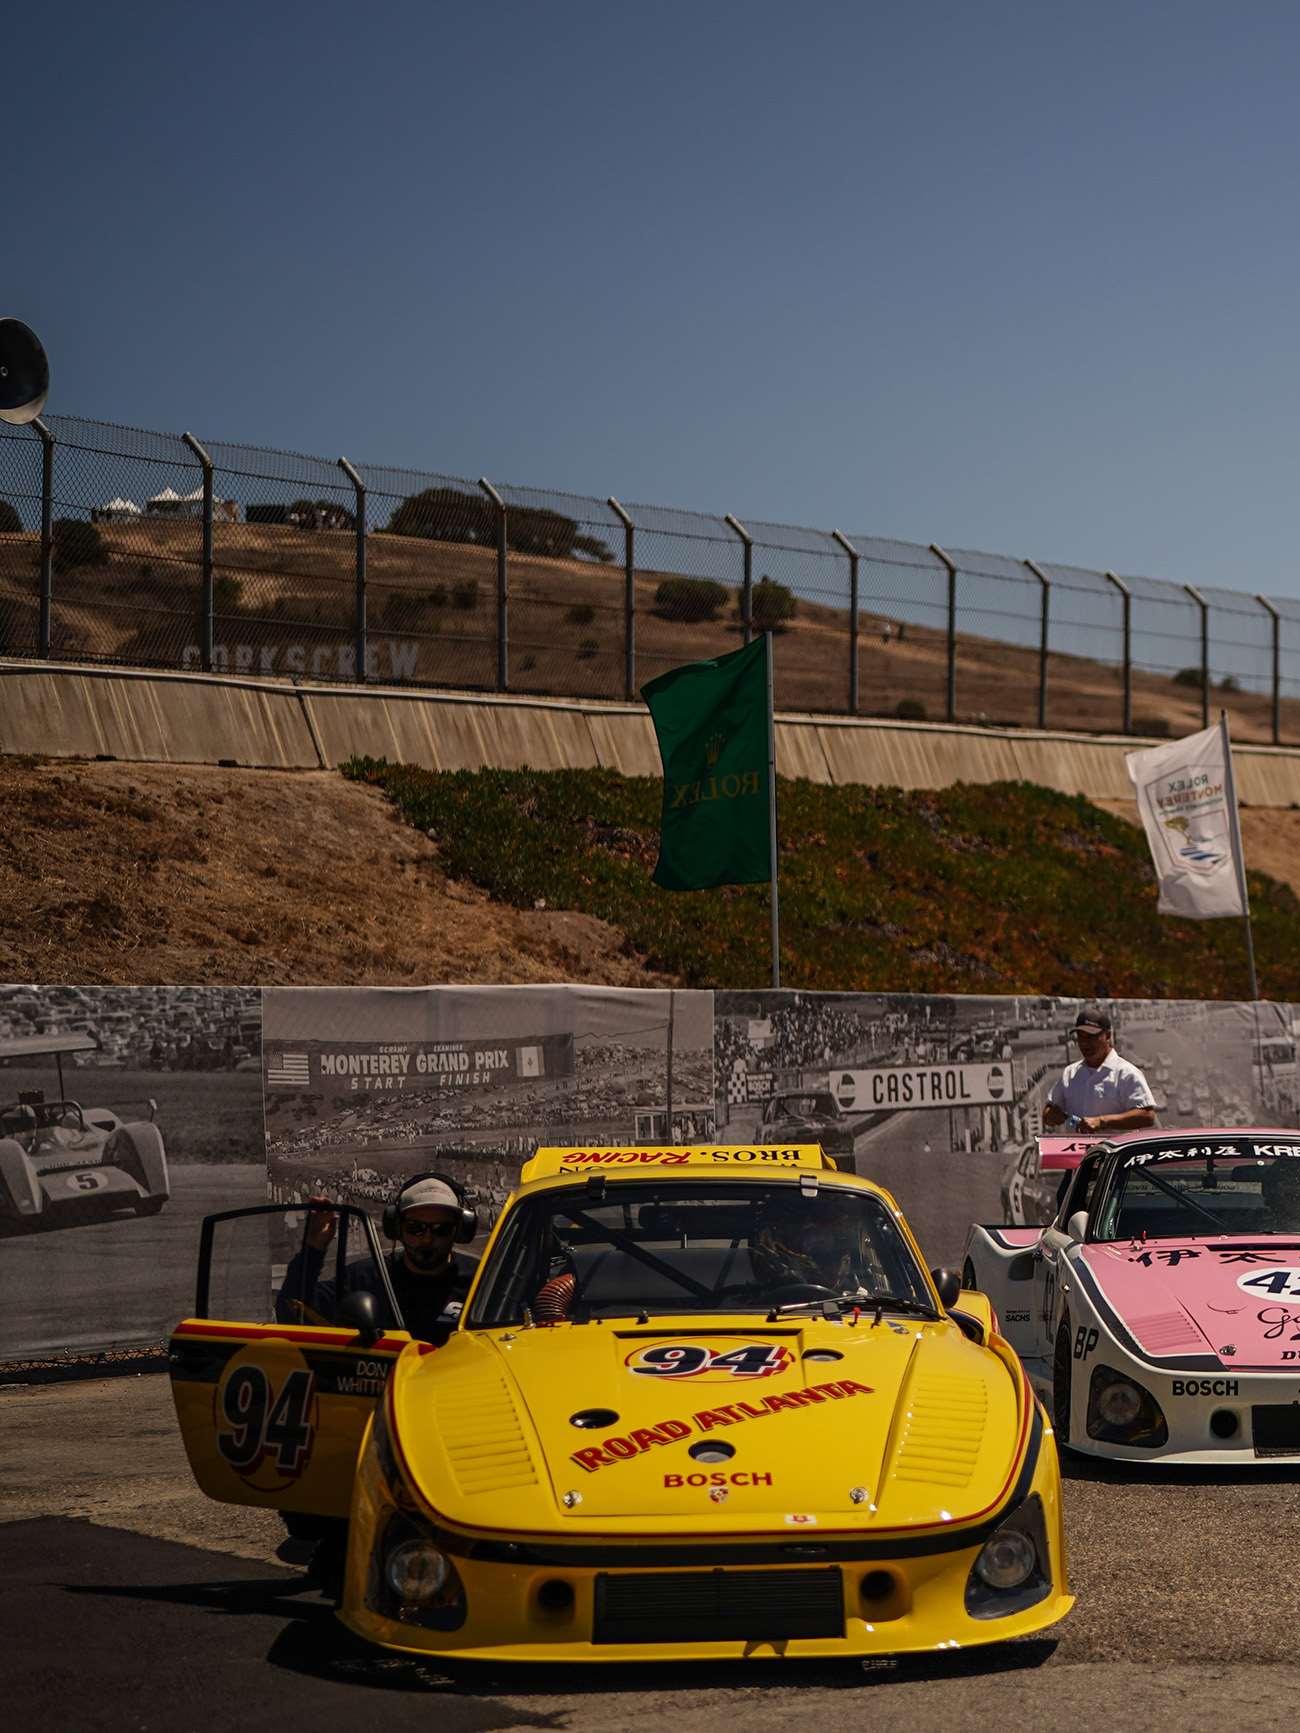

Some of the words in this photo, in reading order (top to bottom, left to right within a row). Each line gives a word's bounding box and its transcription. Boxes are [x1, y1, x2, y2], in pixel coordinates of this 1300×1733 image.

[320, 1054, 411, 1075] MONTEREY
[416, 1051, 469, 1074] GRAND
[475, 1049, 510, 1071] PRIX
[351, 1076, 406, 1090] START
[439, 1072, 491, 1087] FINISH
[872, 1070, 972, 1105] CASTROL
[561, 1152, 693, 1165] RACING
[701, 1150, 801, 1163] BROS.
[75, 1173, 99, 1190] 5
[1005, 1312, 1031, 1322] SACHS
[1074, 1326, 1099, 1361] BP
[356, 1360, 388, 1377] DON
[629, 1343, 788, 1377] 94
[1172, 1379, 1240, 1397] BOSCH
[216, 1362, 316, 1473] 94
[570, 1419, 692, 1473] ROAD
[692, 1379, 875, 1432] ATLANTA
[663, 1472, 773, 1488] BOSCH
